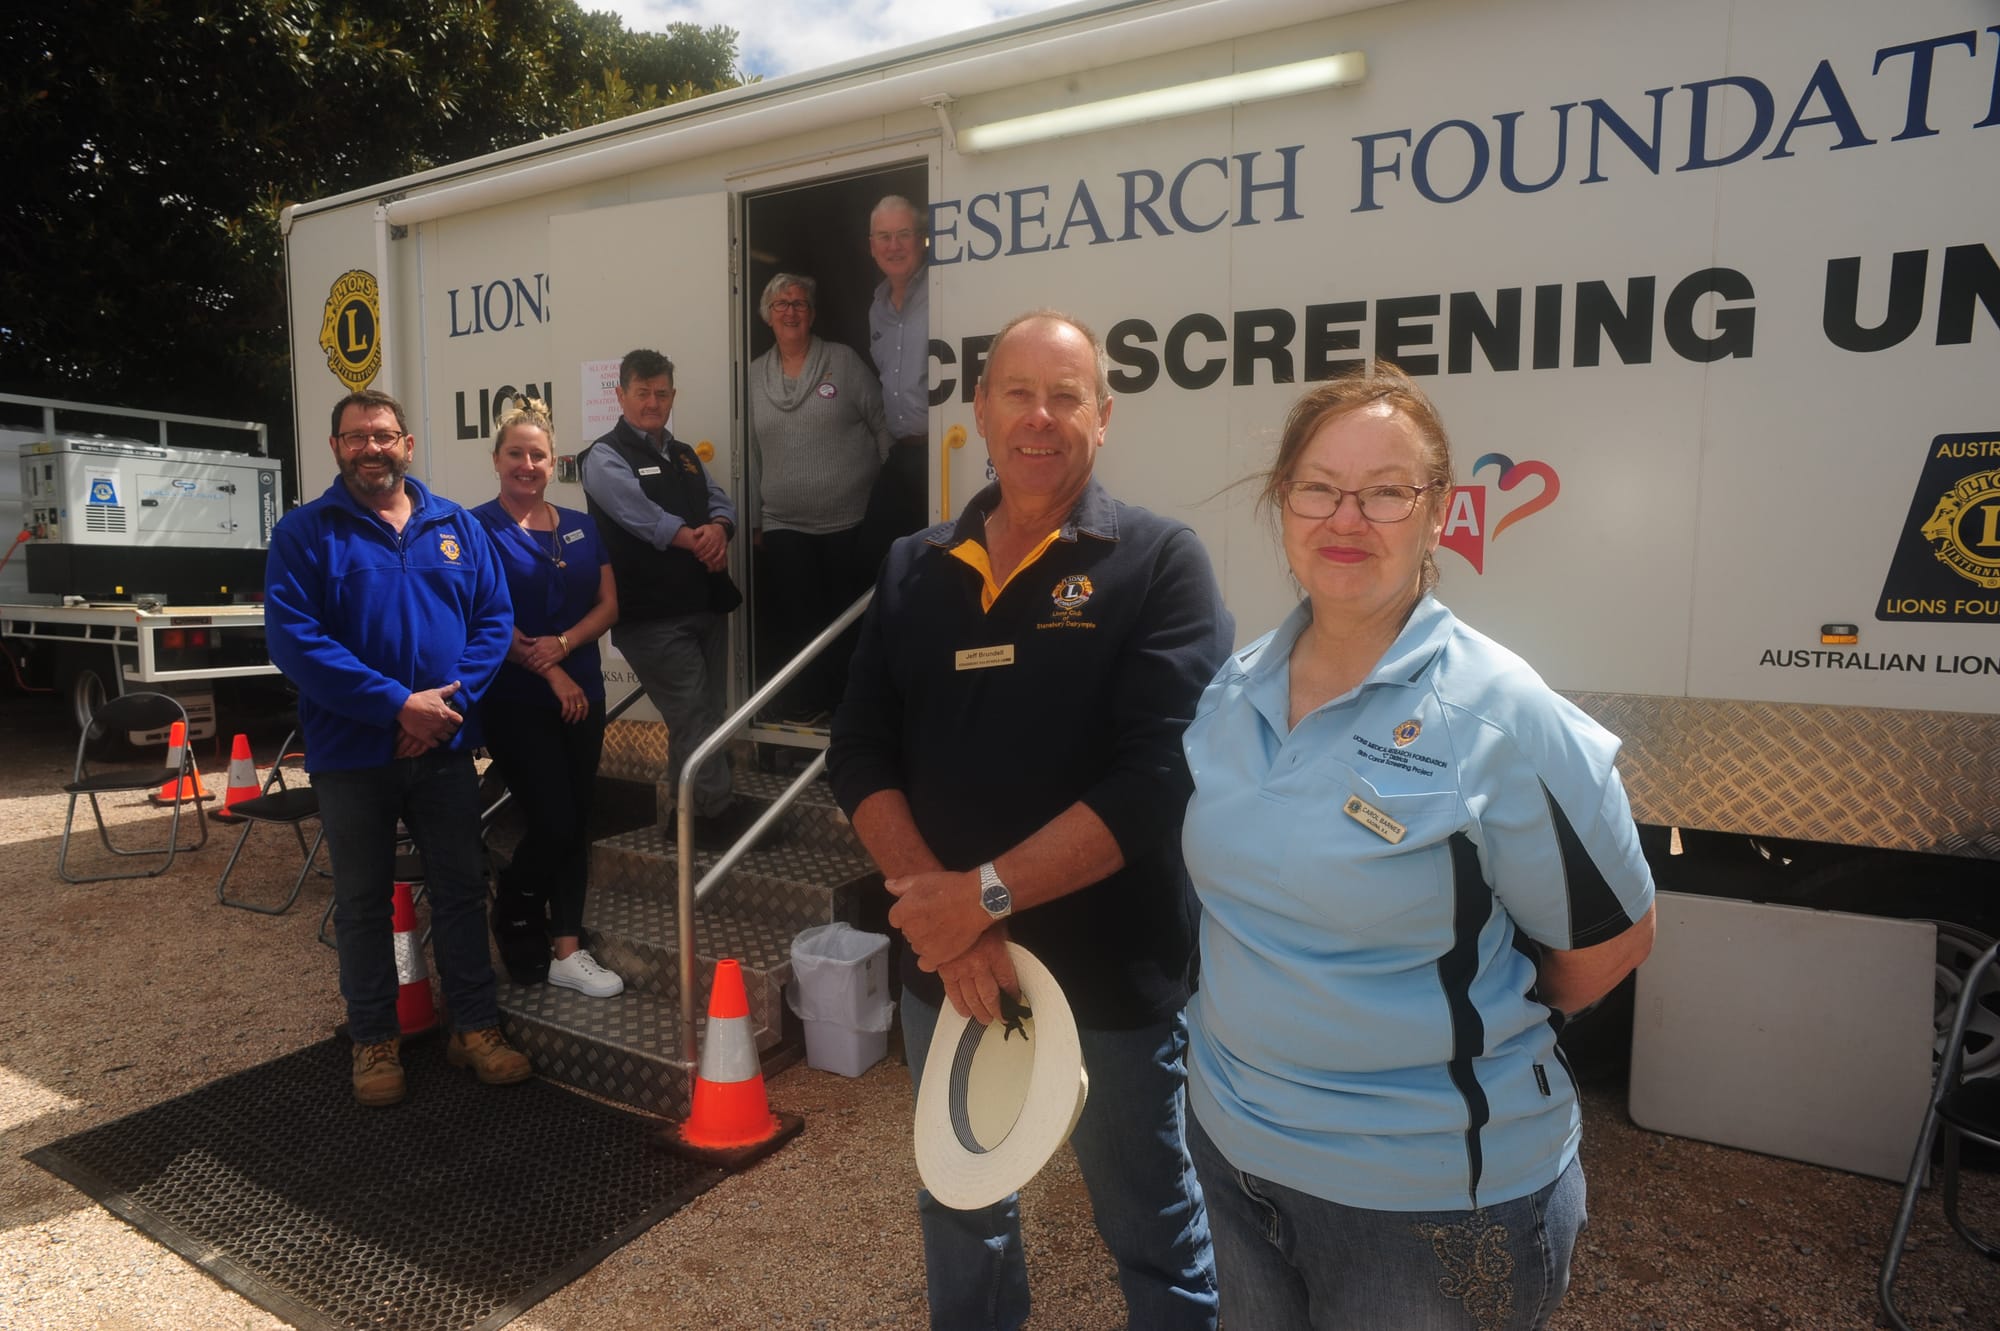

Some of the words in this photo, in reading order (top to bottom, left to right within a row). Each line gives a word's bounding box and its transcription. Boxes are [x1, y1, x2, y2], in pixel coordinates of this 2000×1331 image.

[334, 275, 373, 305] LIONS
[448, 273, 549, 337] LION
[345, 308, 368, 352] L
[1105, 268, 1756, 394] SCREENING
[1823, 243, 2000, 352] UN
[1936, 441, 2000, 458] AUSTR
[263, 492, 273, 542] HIMOINSA
[1444, 491, 1480, 537] A
[1065, 584, 1078, 599] L
[1886, 599, 1947, 614] LIONS
[1954, 599, 2000, 615] FOU
[1759, 649, 1926, 672] AUSTRALIAN
[1936, 654, 2000, 675] LION
